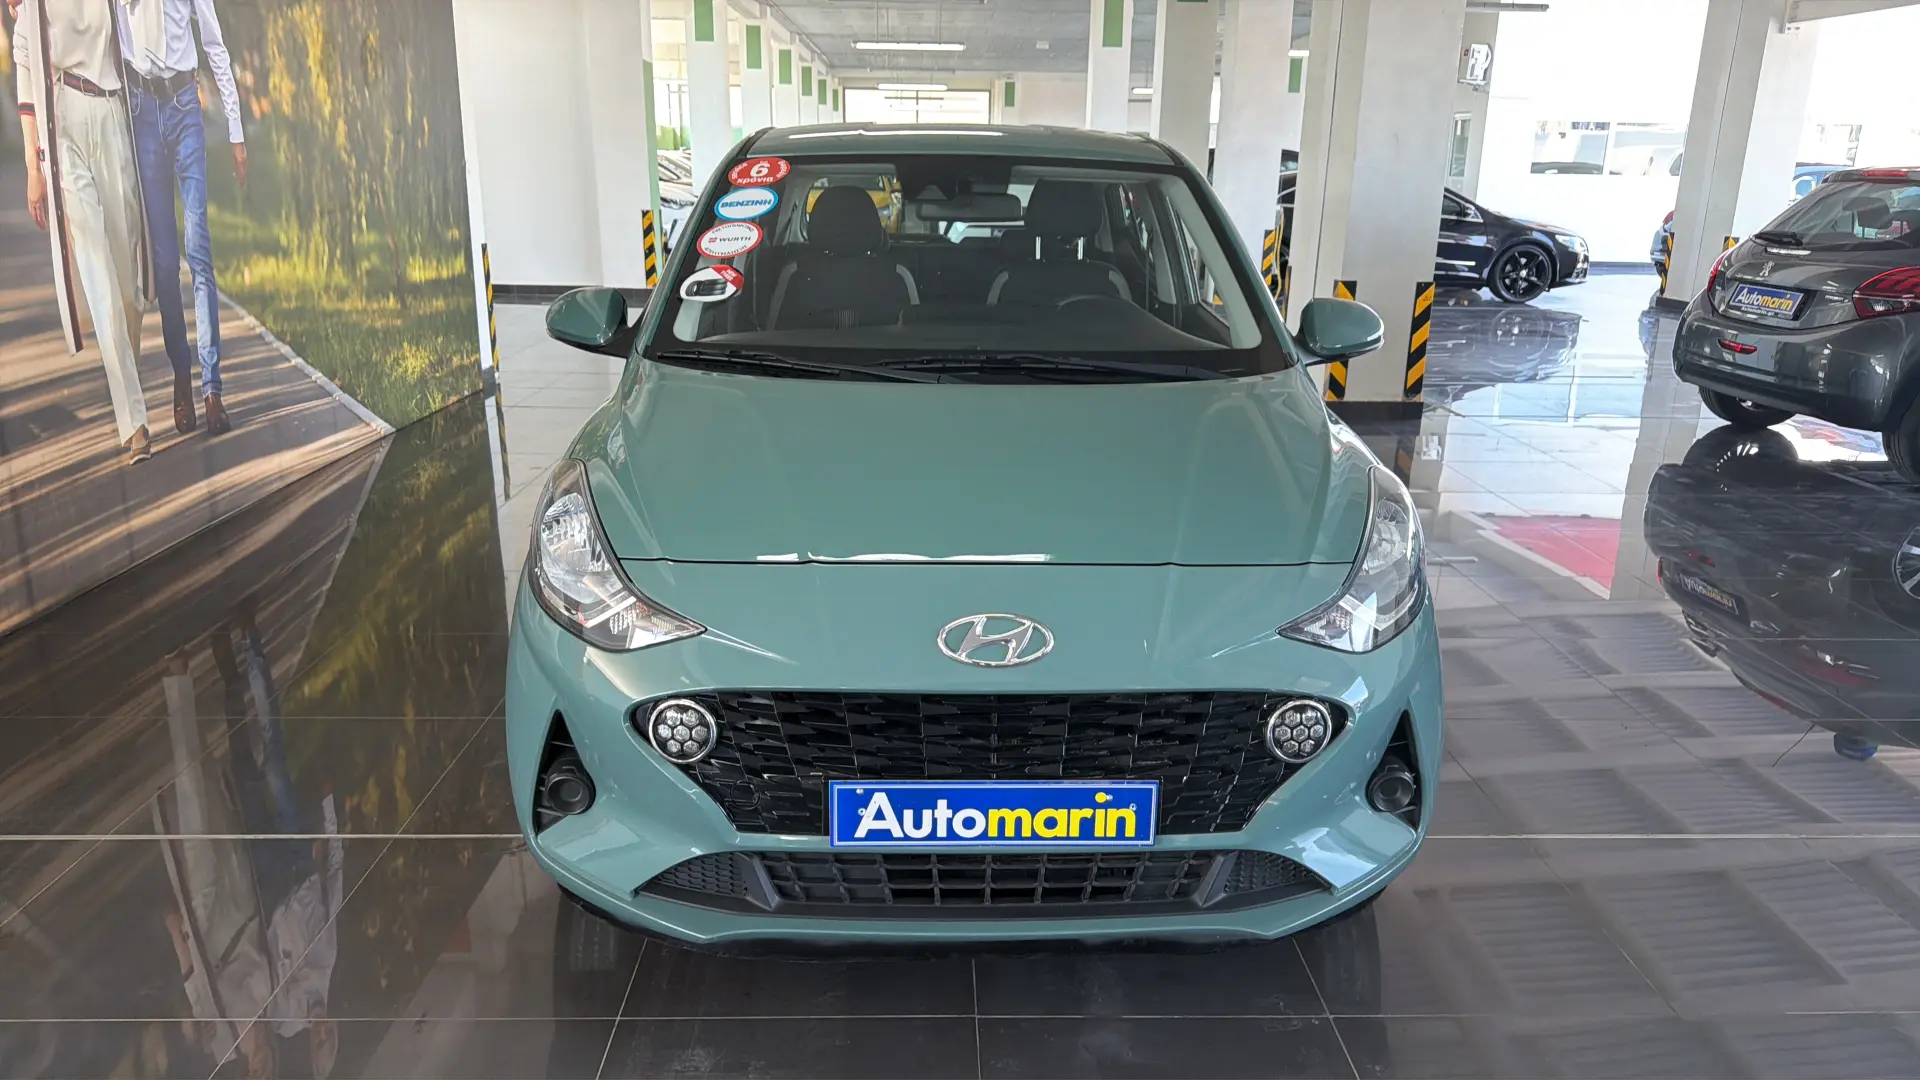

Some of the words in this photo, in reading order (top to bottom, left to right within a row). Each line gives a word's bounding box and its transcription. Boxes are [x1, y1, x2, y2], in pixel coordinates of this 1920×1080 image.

[750, 162, 770, 178] 6
[1735, 287, 1793, 311] Automarin
[854, 791, 1136, 838] Automarin
